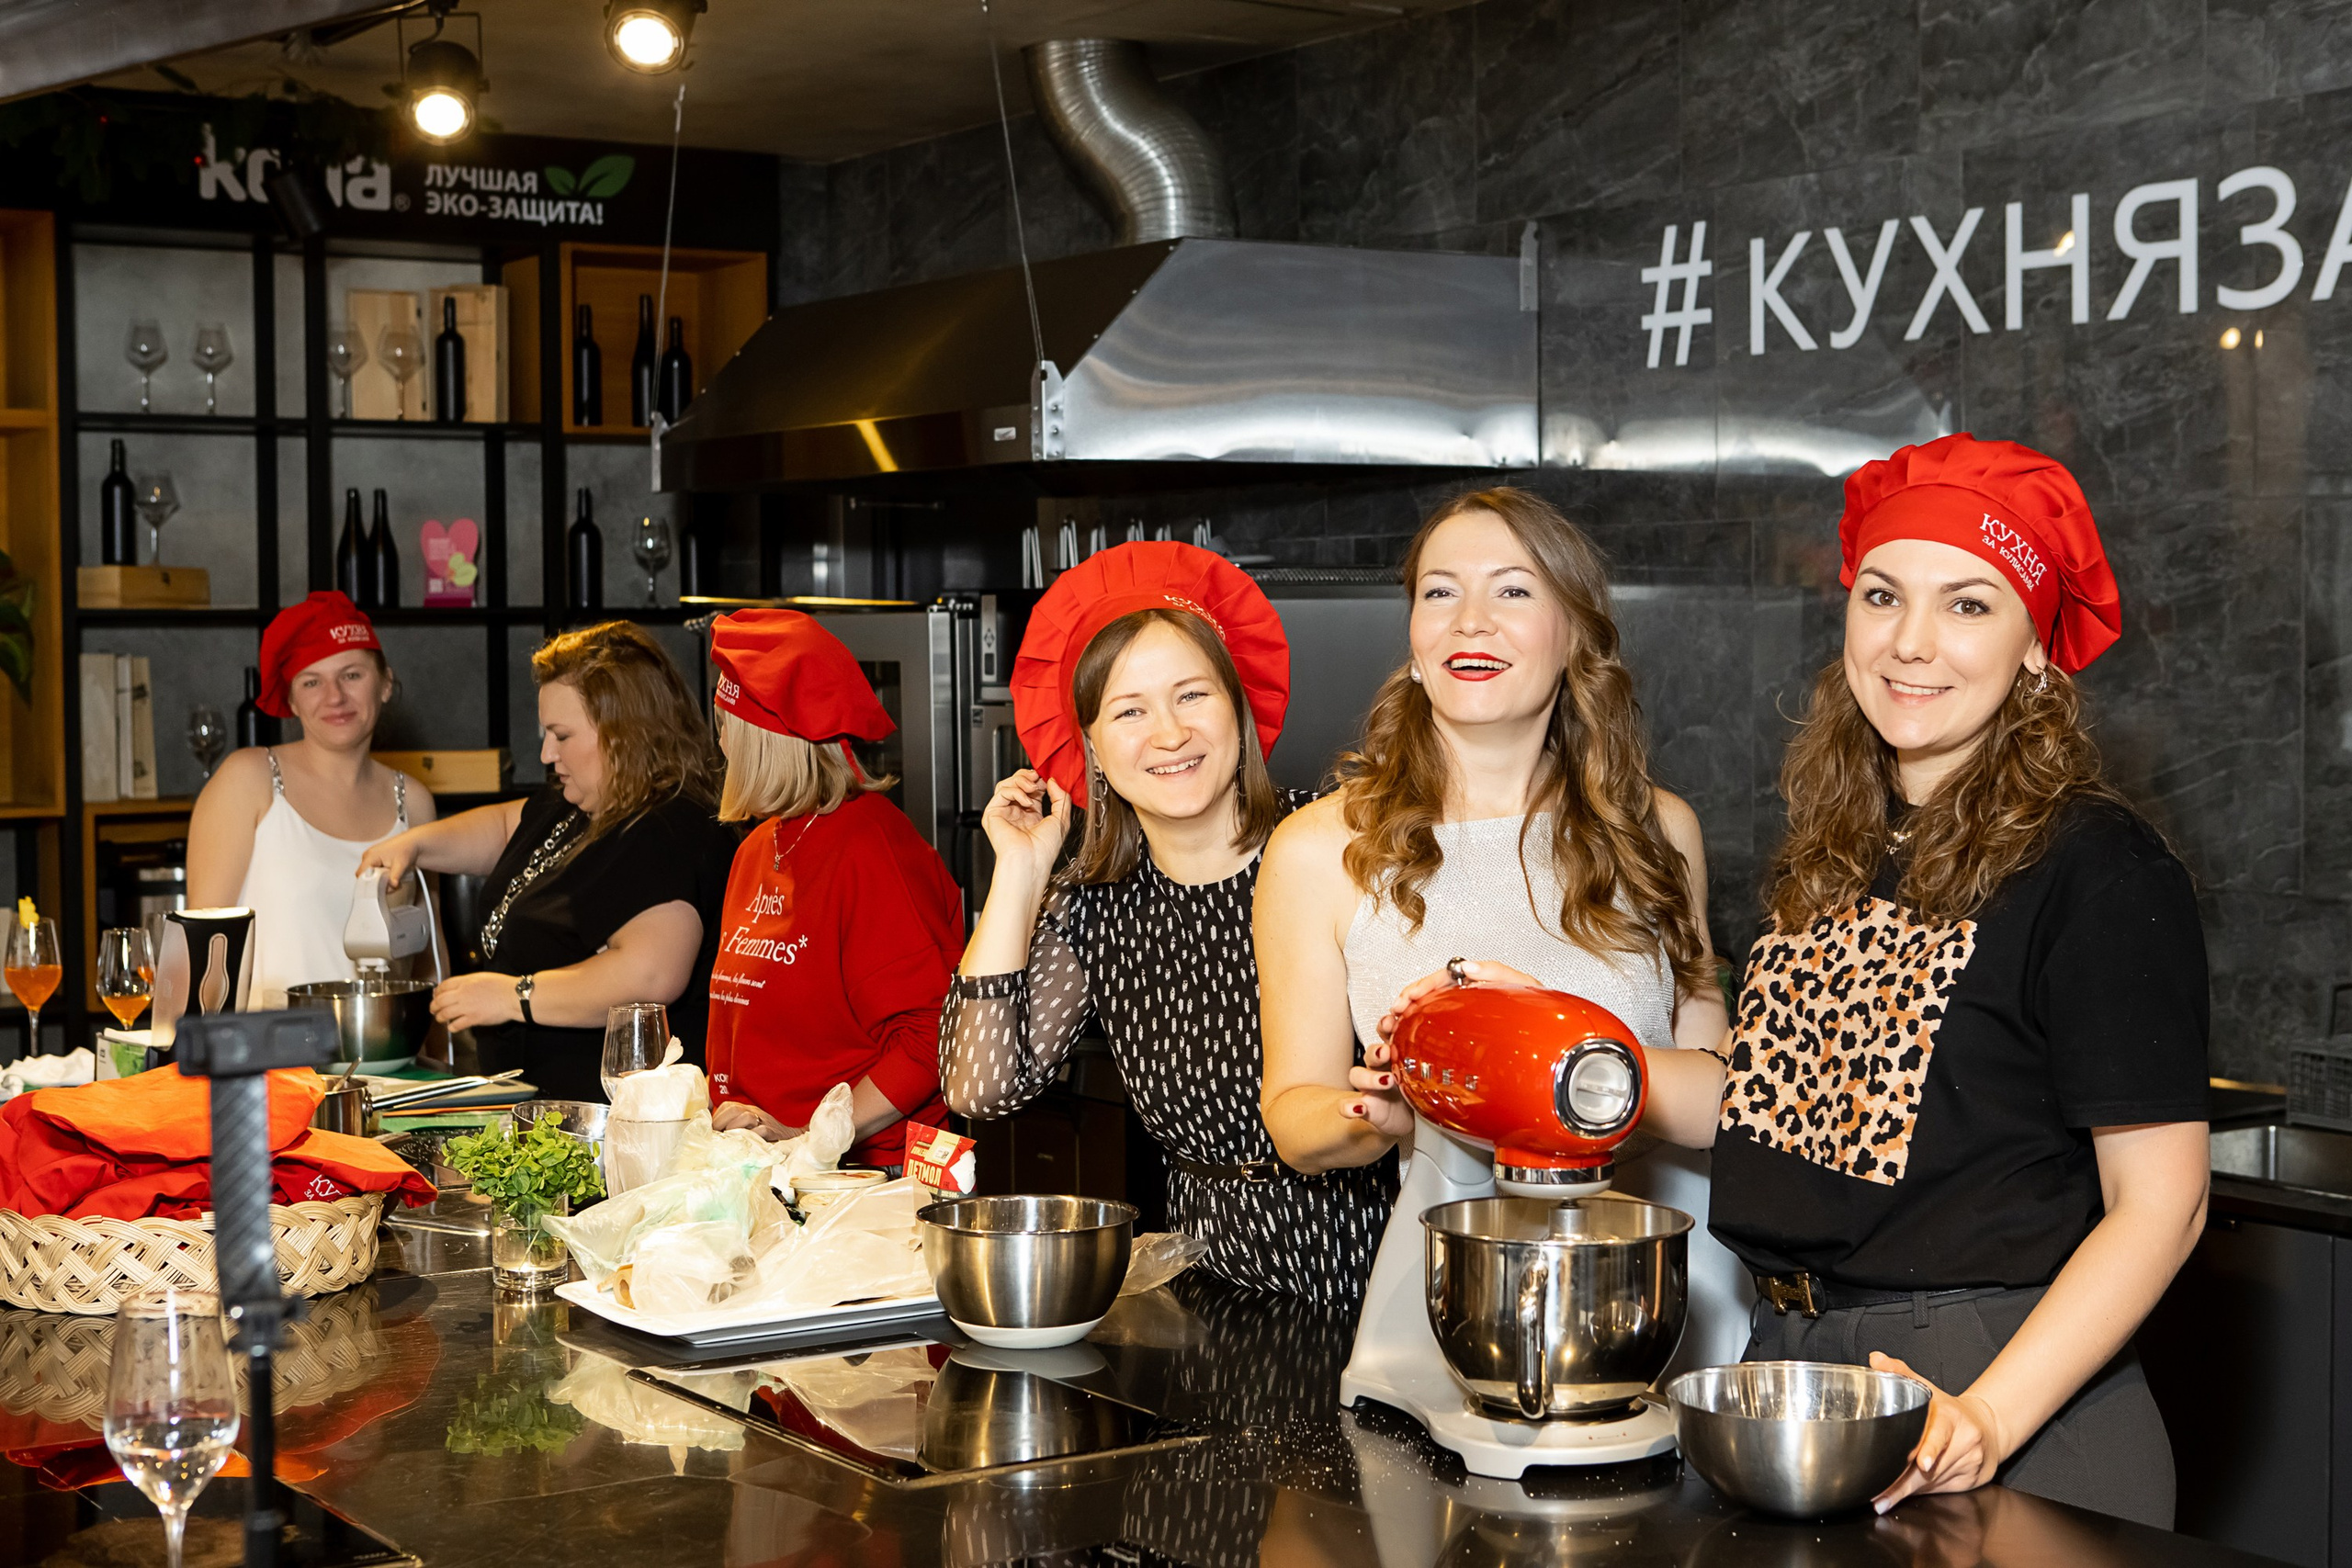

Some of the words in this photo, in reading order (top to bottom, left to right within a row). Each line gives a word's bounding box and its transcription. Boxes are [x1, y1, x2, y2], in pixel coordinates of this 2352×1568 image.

[424, 164, 538, 194] ЛУЧШАЯ
[425, 191, 604, 226] ЭКО-ЗАЩИТА!
[1979, 513, 2047, 586] КУХНЯ
[1982, 535, 1996, 549] ЗА
[1998, 546, 2035, 592] КУЛИСАМИ
[745, 883, 786, 924] Après
